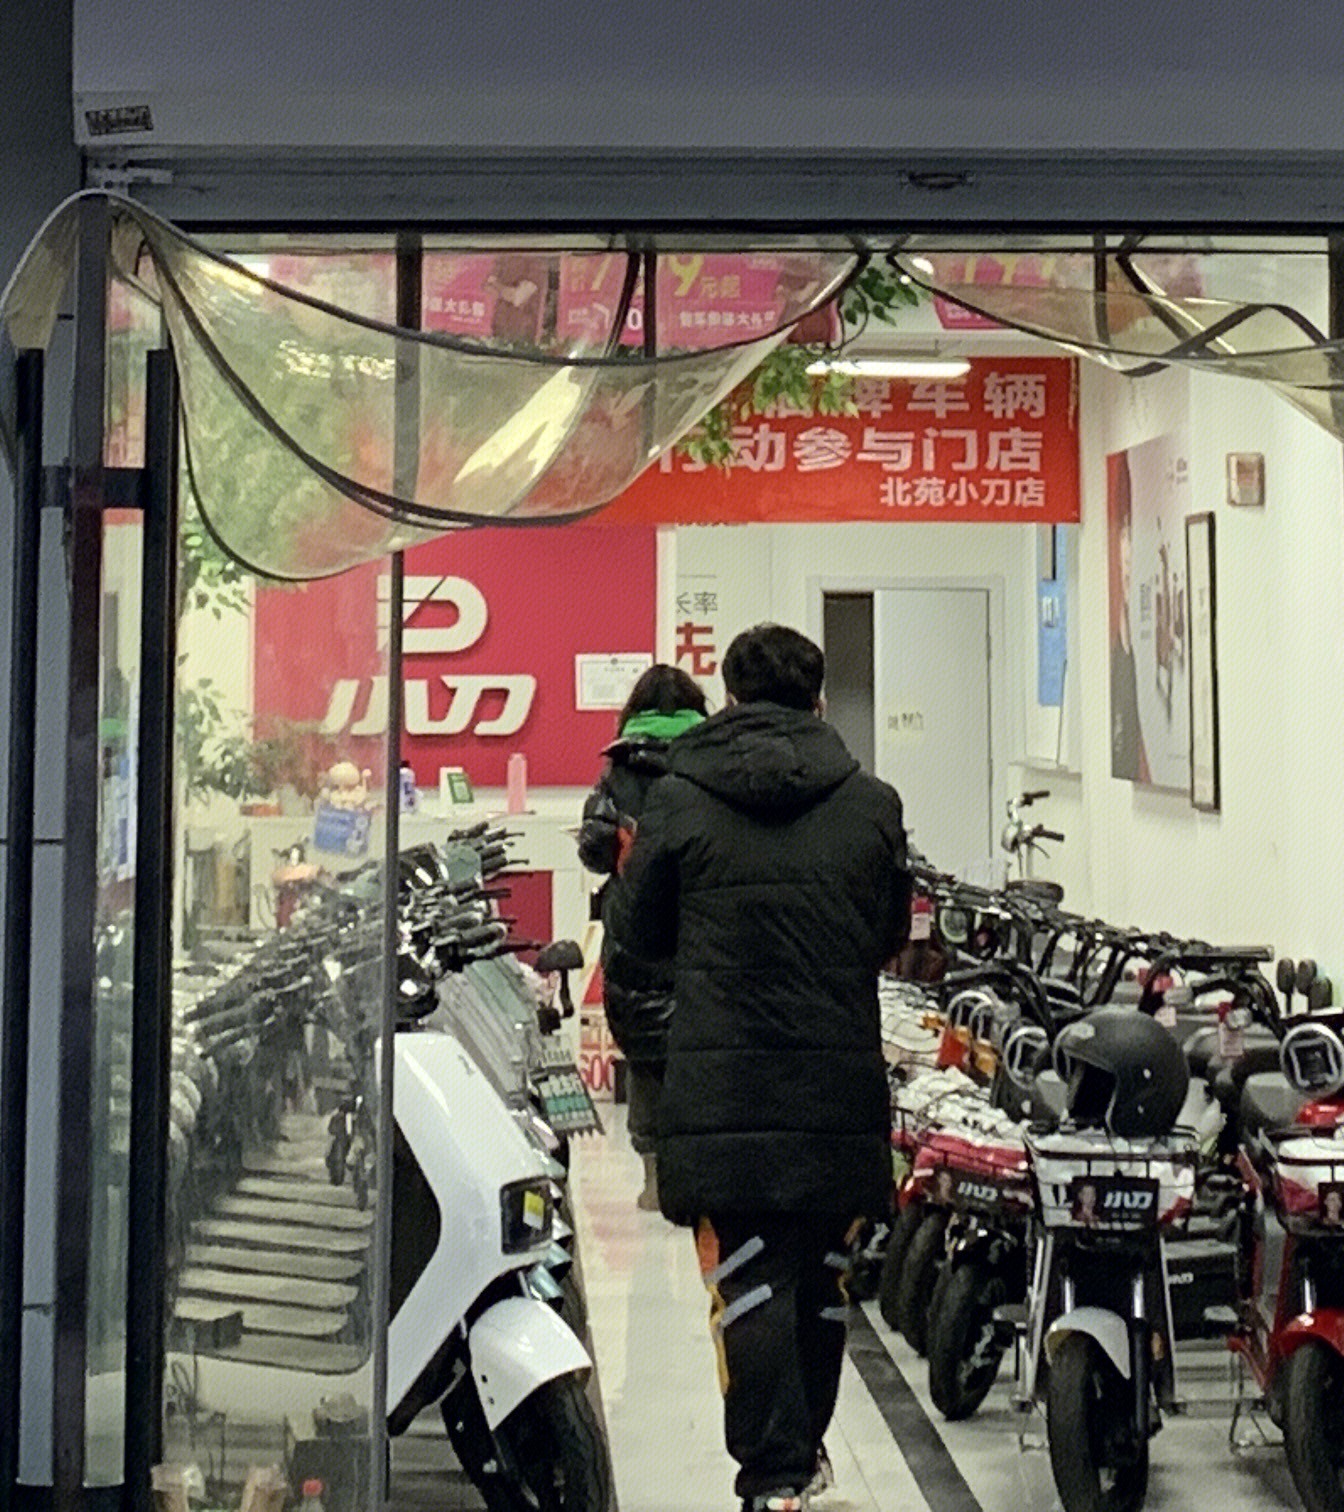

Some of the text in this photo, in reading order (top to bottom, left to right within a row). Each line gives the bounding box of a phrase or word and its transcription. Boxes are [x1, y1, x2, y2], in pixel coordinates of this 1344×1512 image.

[879, 477, 1047, 509] 北苑小刀店
